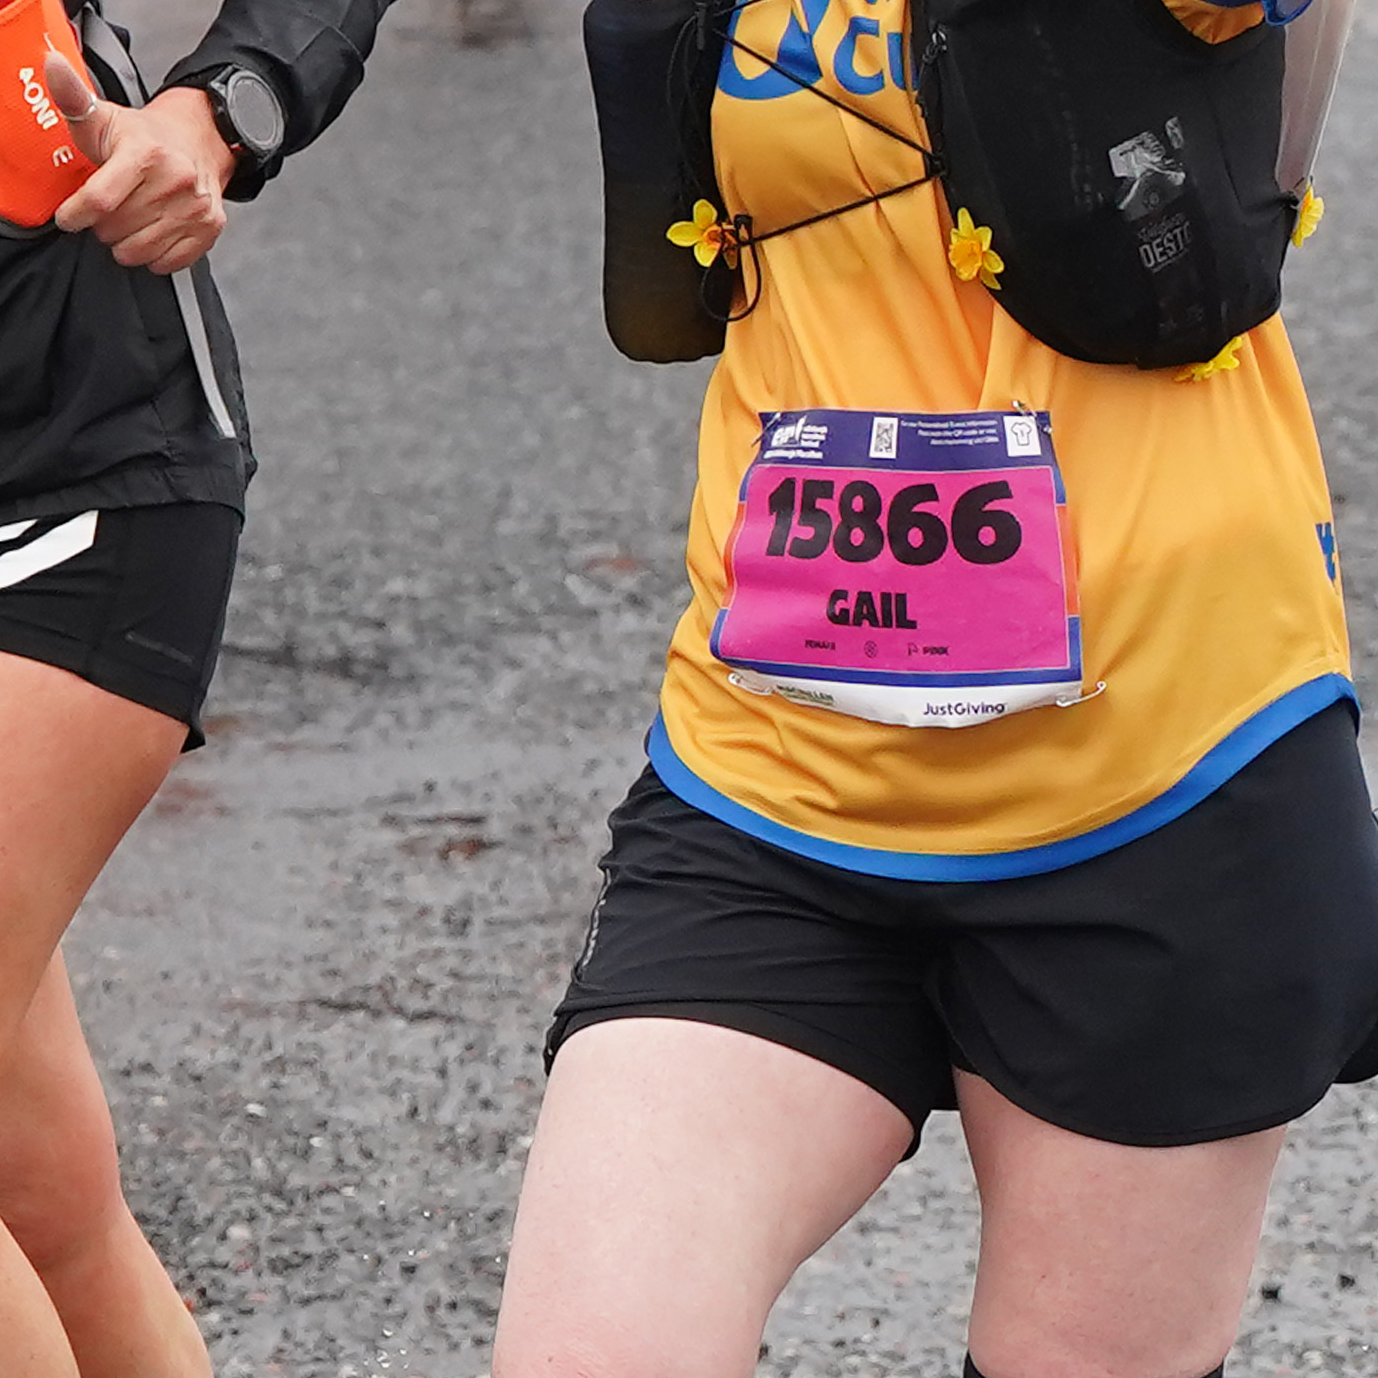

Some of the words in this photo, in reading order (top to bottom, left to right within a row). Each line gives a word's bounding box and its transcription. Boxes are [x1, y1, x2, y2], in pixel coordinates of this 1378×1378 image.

[765, 477, 1022, 565] 15866
[826, 590, 918, 629] GAIL
[923, 701, 1006, 717] JustGiving
